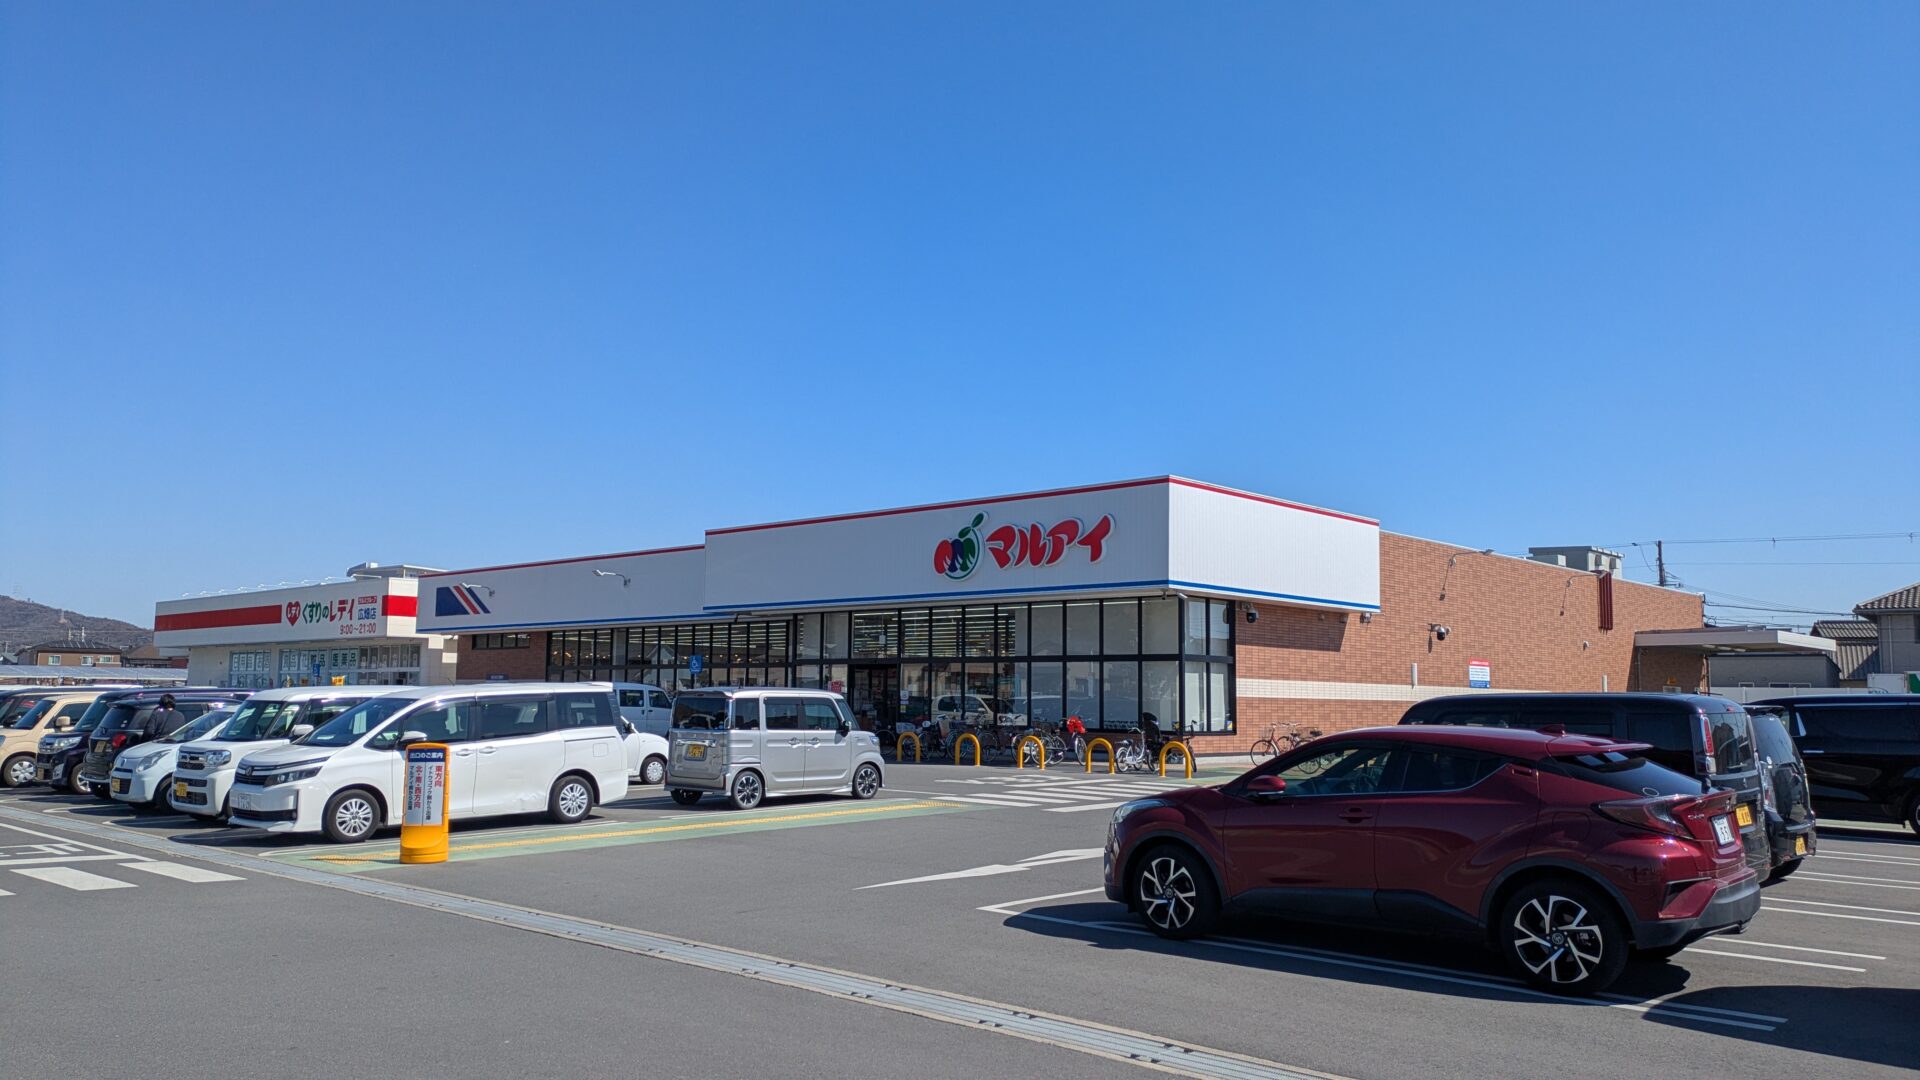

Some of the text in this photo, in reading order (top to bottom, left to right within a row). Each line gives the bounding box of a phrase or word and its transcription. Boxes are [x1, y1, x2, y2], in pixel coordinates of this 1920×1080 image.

[986, 514, 1111, 569] マルアイ
[303, 598, 355, 624] くすりのレディ
[434, 765, 443, 787] 東方向
